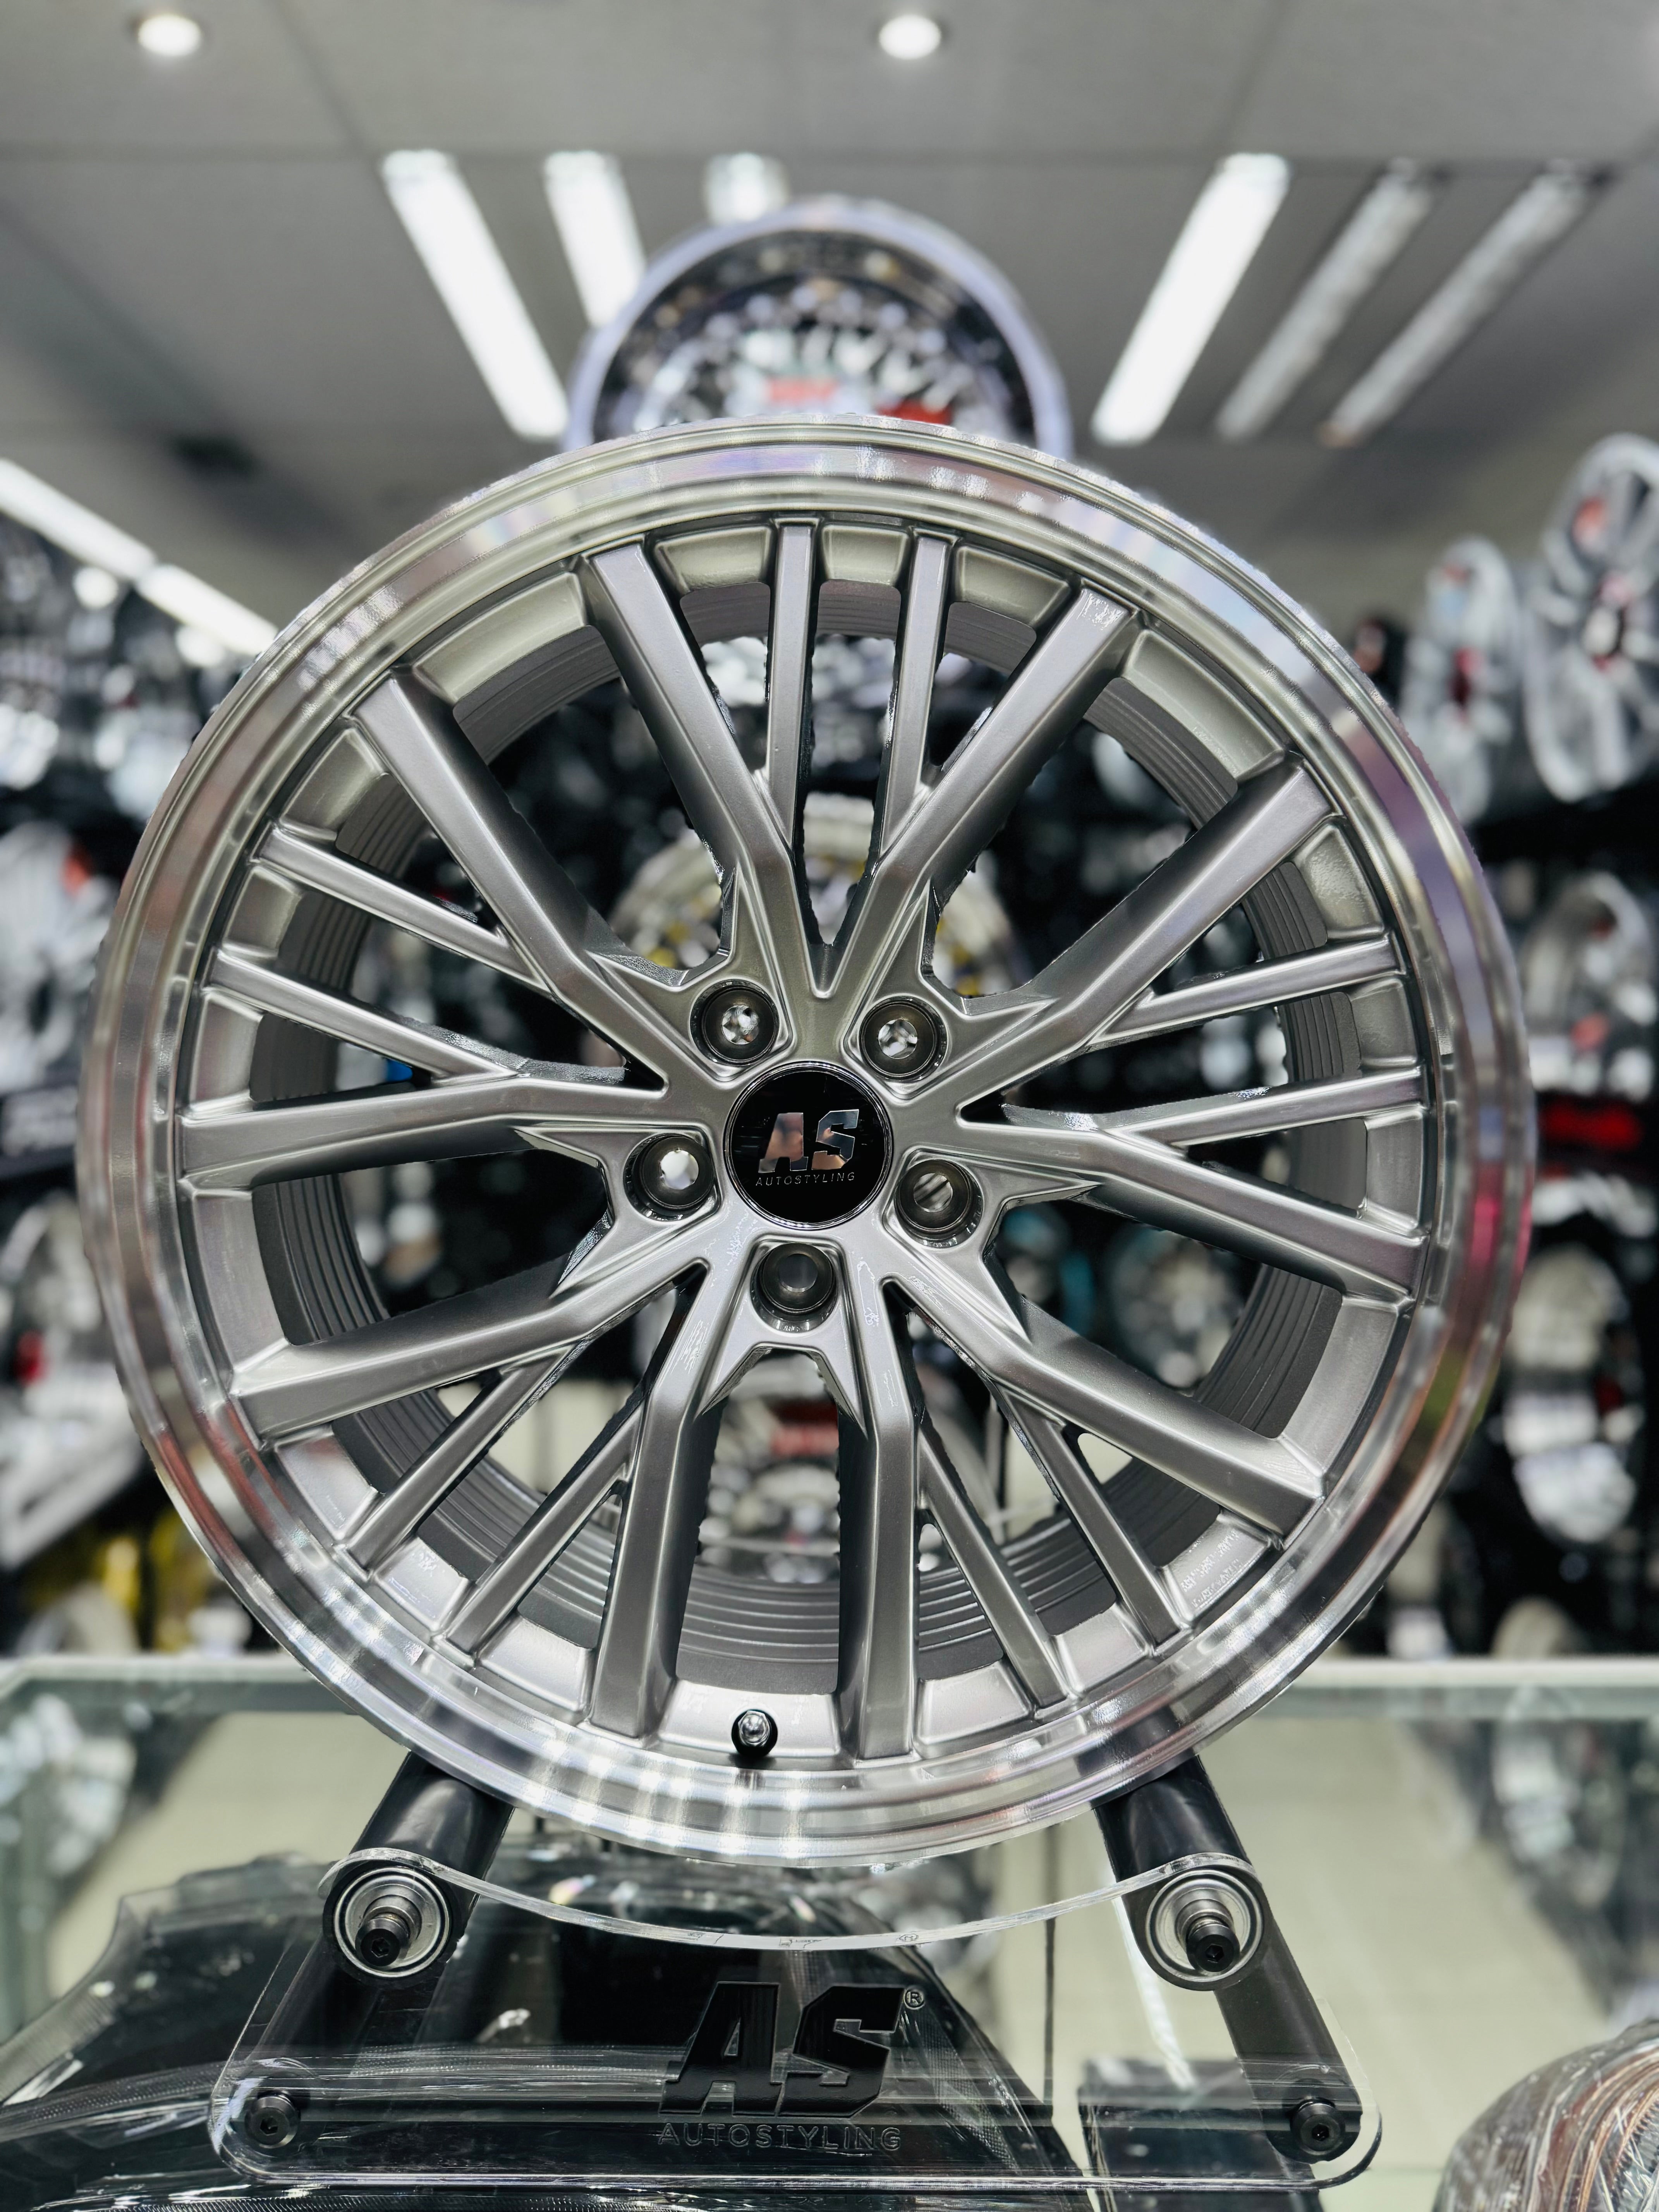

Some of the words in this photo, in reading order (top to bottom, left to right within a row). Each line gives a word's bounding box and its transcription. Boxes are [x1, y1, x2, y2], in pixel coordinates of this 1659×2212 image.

[759, 1109, 859, 1173] AS
[756, 1173, 854, 1186] AUTOSTYLING
[658, 2123, 901, 2150] AUTOSTYLING
